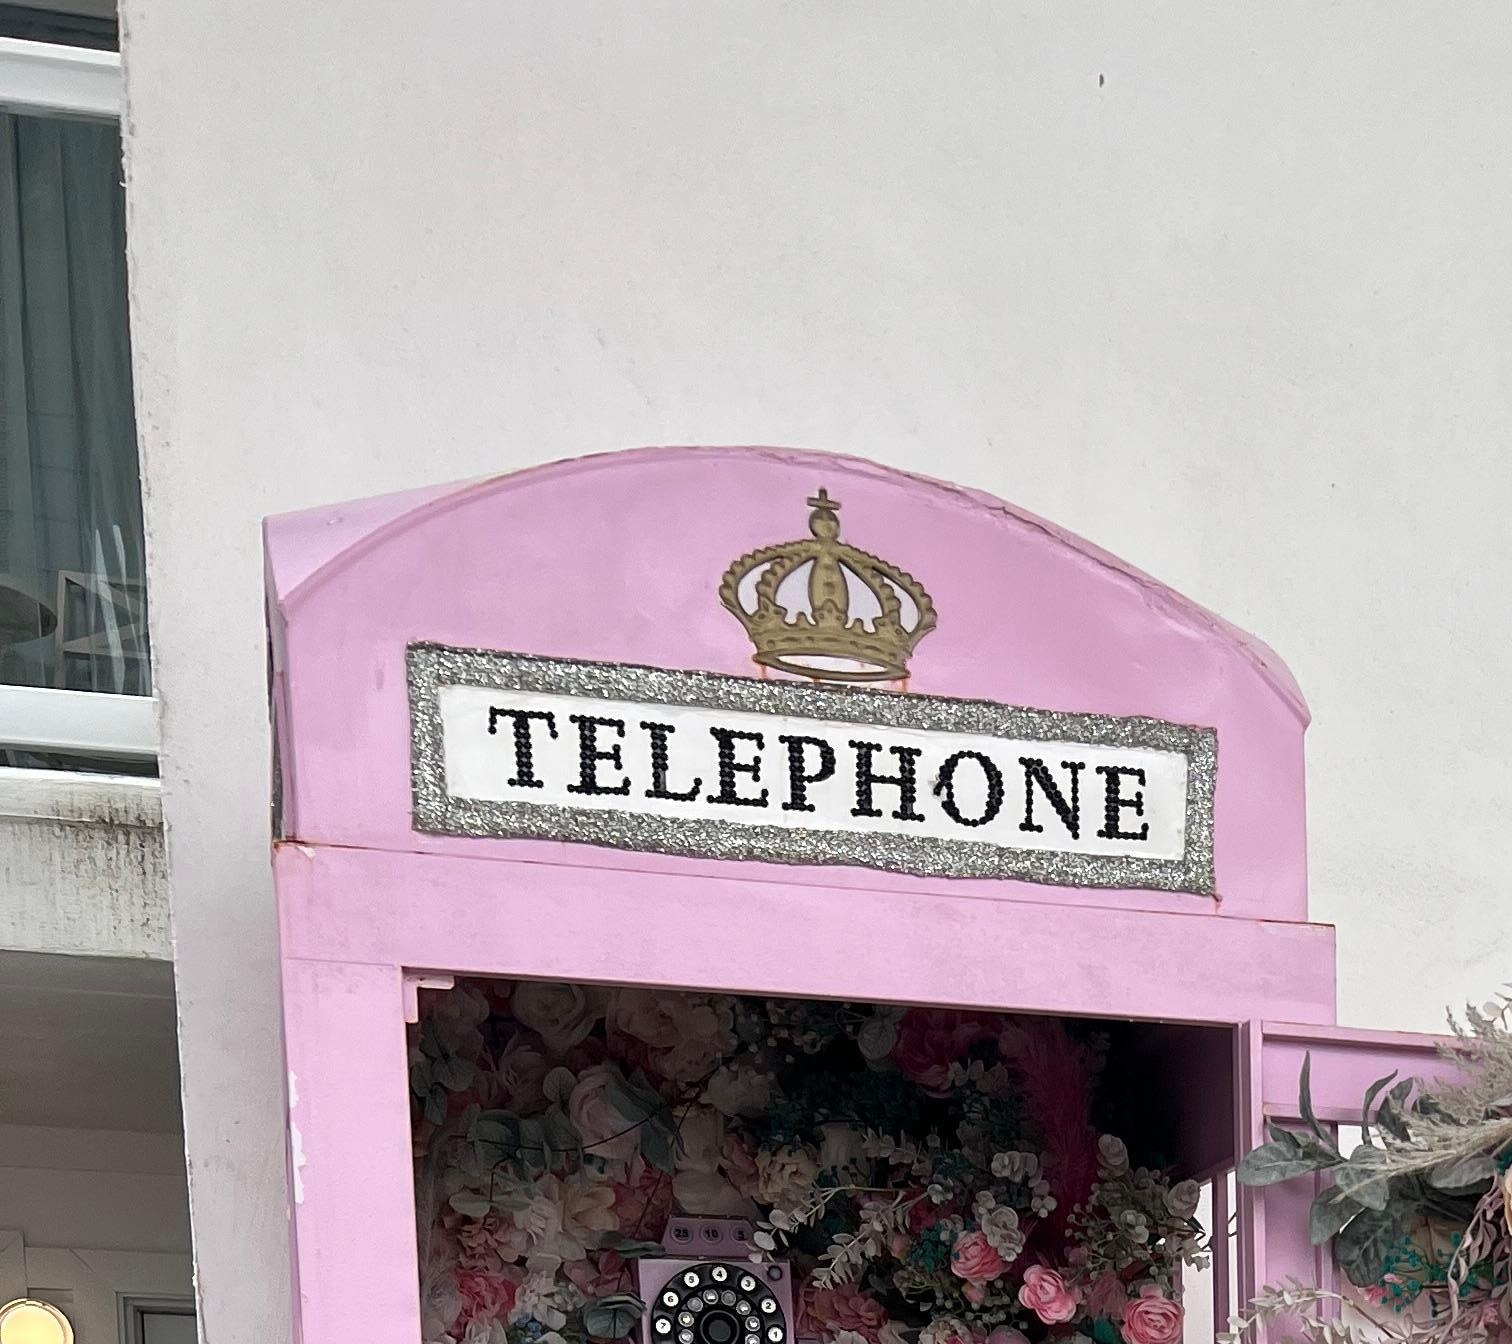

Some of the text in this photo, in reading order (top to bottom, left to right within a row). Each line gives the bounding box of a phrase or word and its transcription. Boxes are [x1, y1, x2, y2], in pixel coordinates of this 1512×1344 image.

[488, 705, 1149, 841] TELEPHONE
[675, 1228, 689, 1238] 25
[704, 1229, 719, 1238] 10
